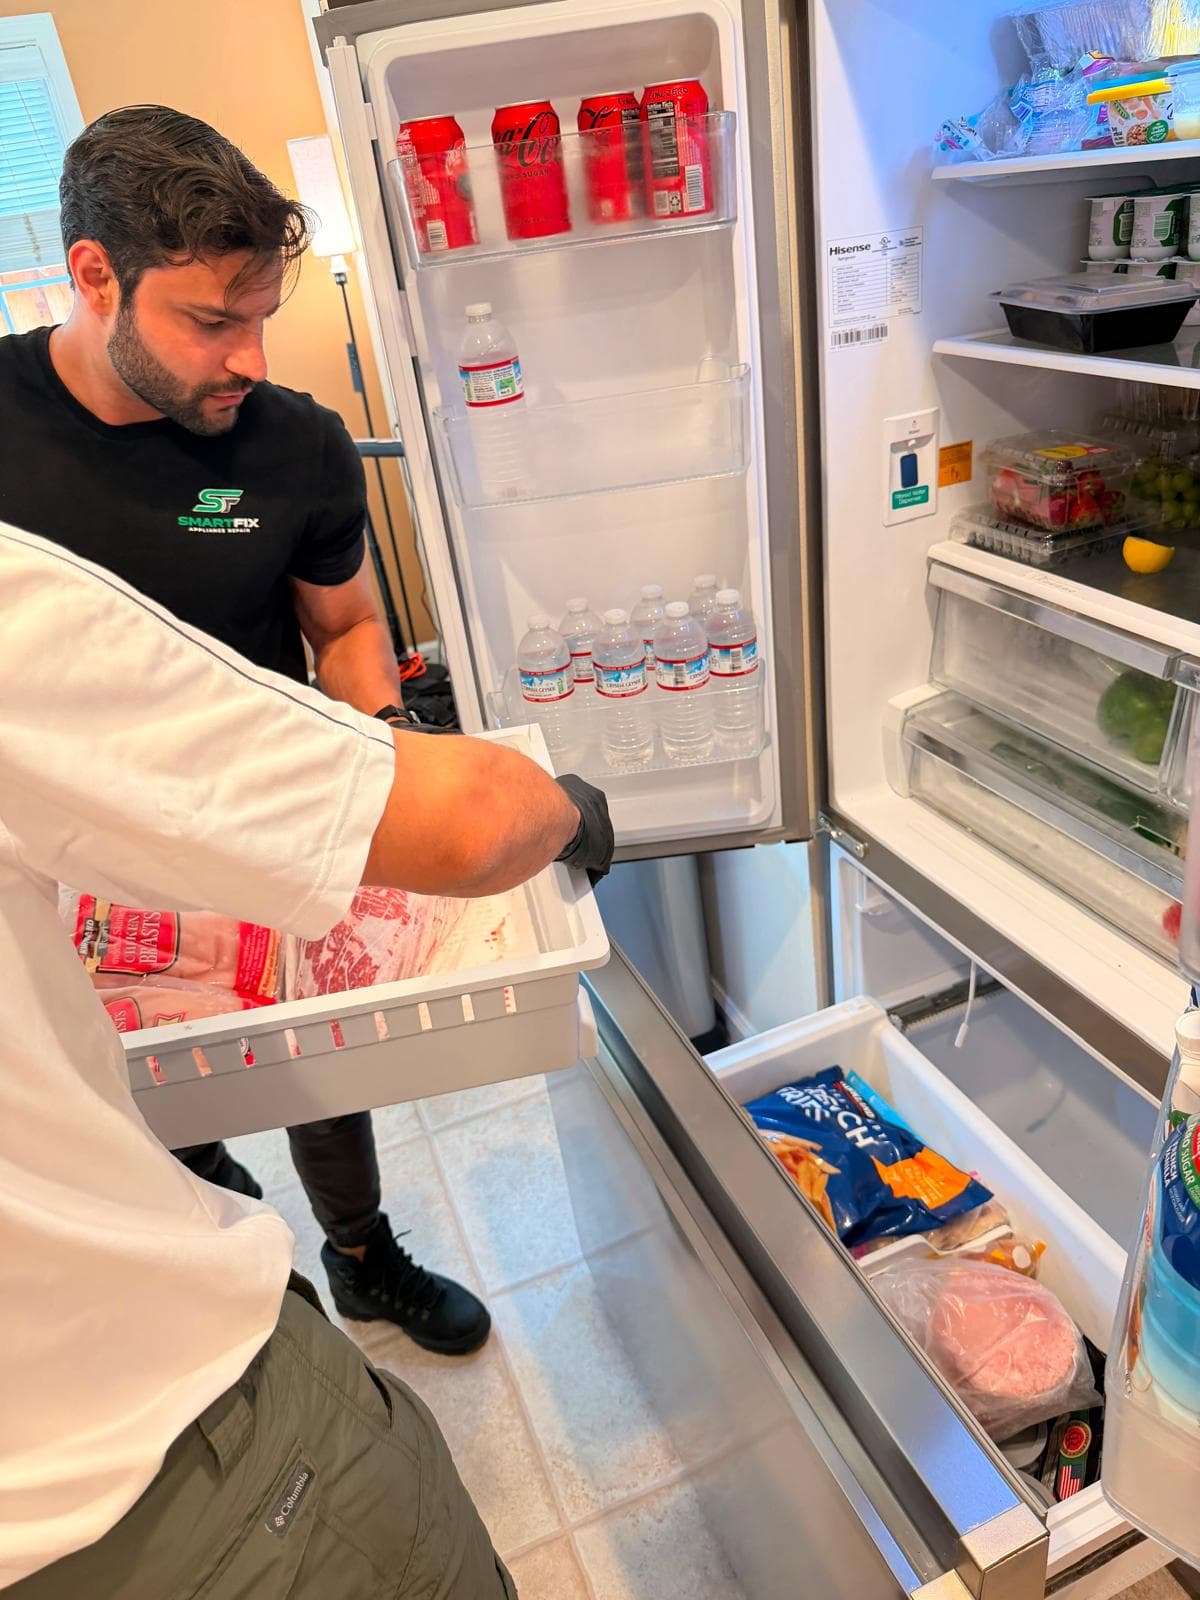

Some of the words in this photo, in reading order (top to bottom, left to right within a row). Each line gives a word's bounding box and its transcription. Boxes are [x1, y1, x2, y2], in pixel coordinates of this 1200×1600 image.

[829, 243, 871, 256] Hisense
[192, 488, 244, 513] SF
[177, 516, 260, 528] SMARTFIX
[1181, 1147, 1196, 1185] SUGAR
[281, 1472, 309, 1516] Columbia
